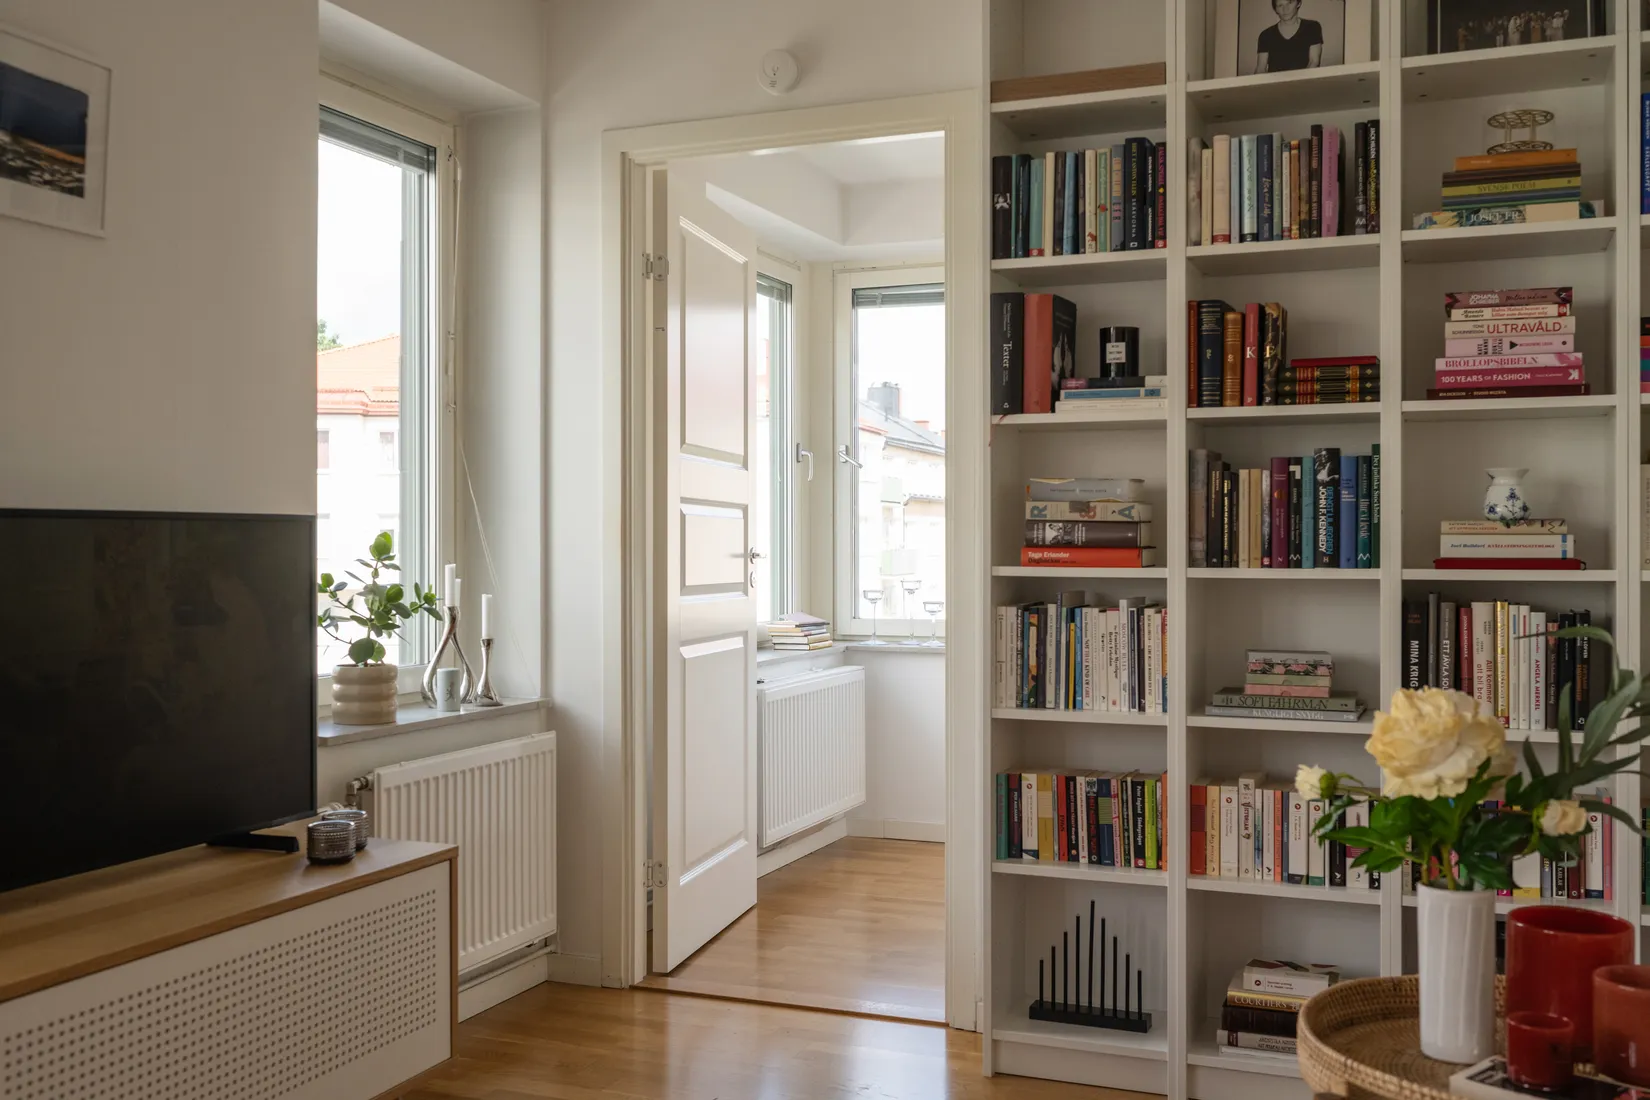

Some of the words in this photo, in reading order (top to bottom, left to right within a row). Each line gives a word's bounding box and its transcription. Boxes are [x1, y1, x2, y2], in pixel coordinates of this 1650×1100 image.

[1478, 183, 1509, 192] SVENSK
[1469, 211, 1501, 222] JOSEF
[1487, 320, 1562, 334] ULTRAVÅLD
[1003, 341, 1012, 368] Texter
[1246, 346, 1256, 358] K
[1445, 357, 1538, 368] BRÖLLOPSBIBELN
[1493, 373, 1530, 382] FASHION
[1410, 640, 1418, 664] MINA
[1442, 654, 1451, 677] JÄVLA
[1410, 666, 1418, 687] KRIG
[1238, 696, 1264, 706] SOFI
[1234, 996, 1287, 1008] COURTIERS
